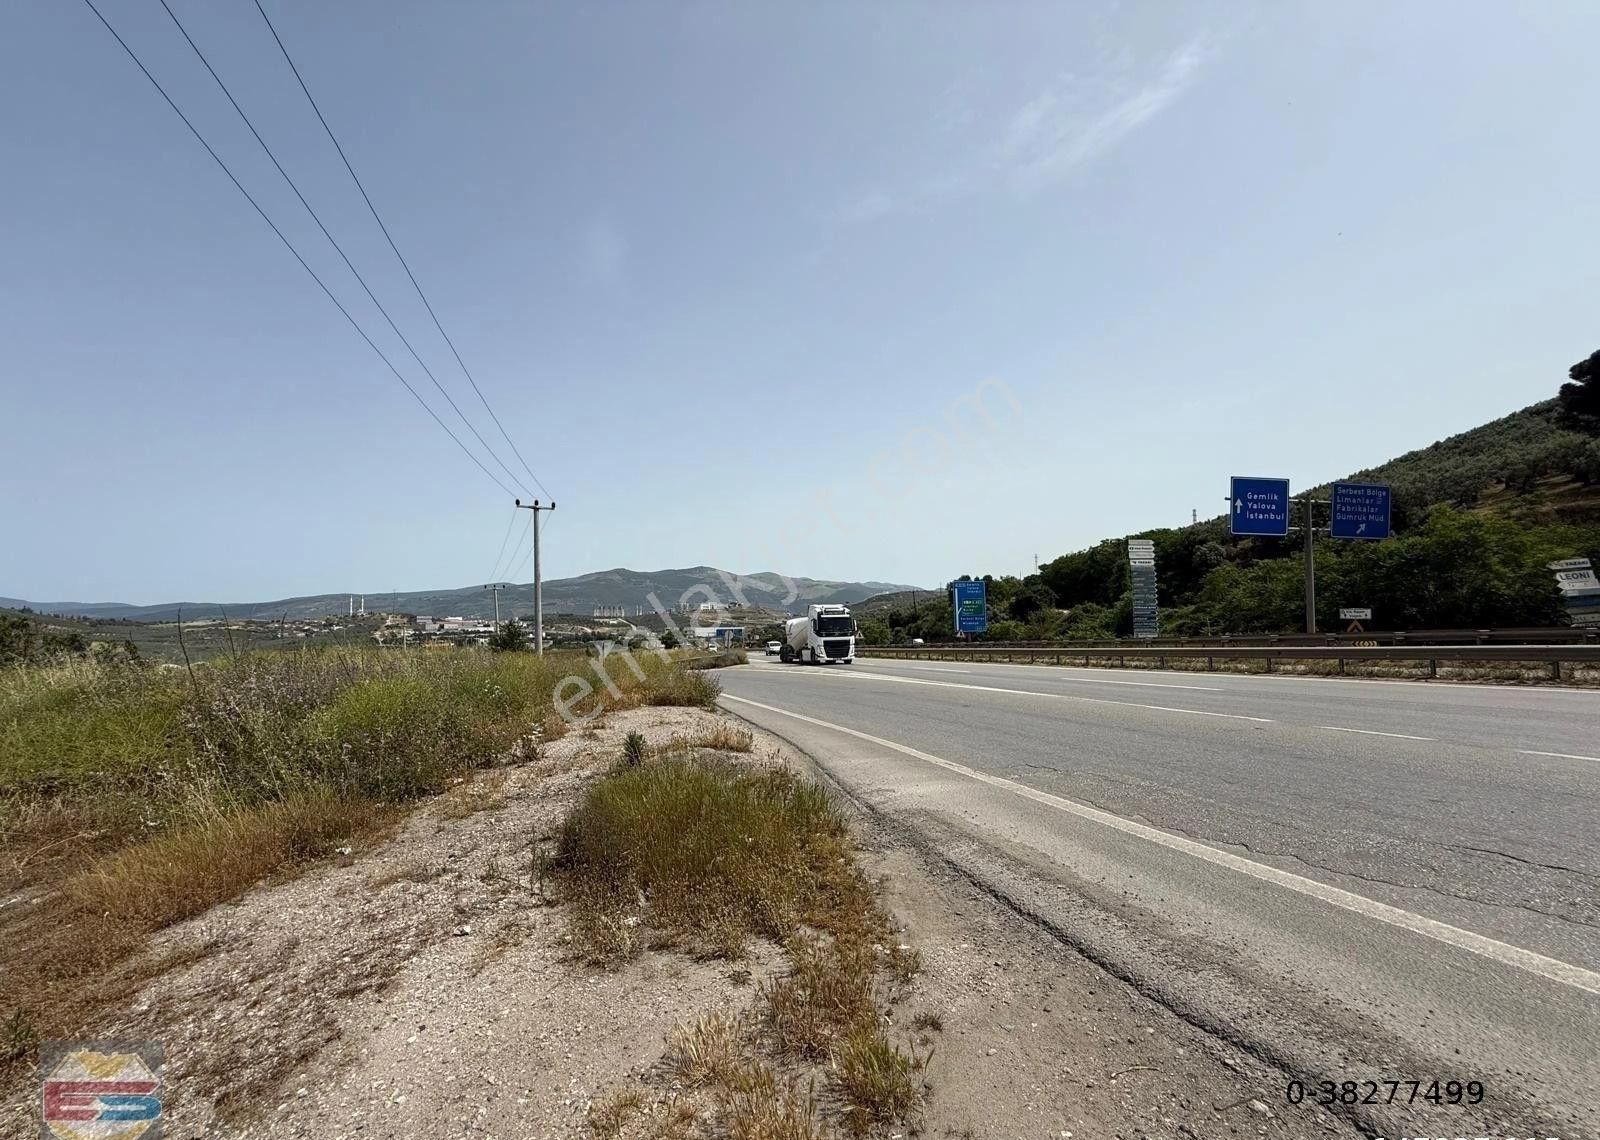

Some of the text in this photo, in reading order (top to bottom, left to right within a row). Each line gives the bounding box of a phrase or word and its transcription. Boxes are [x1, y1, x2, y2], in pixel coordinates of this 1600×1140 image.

[1246, 491, 1279, 500] Gemlik
[1336, 496, 1374, 504] Limanlar
[1247, 501, 1276, 510] Yalova
[1336, 504, 1379, 513] Fabrikalar
[1559, 571, 1591, 581] LEONI
